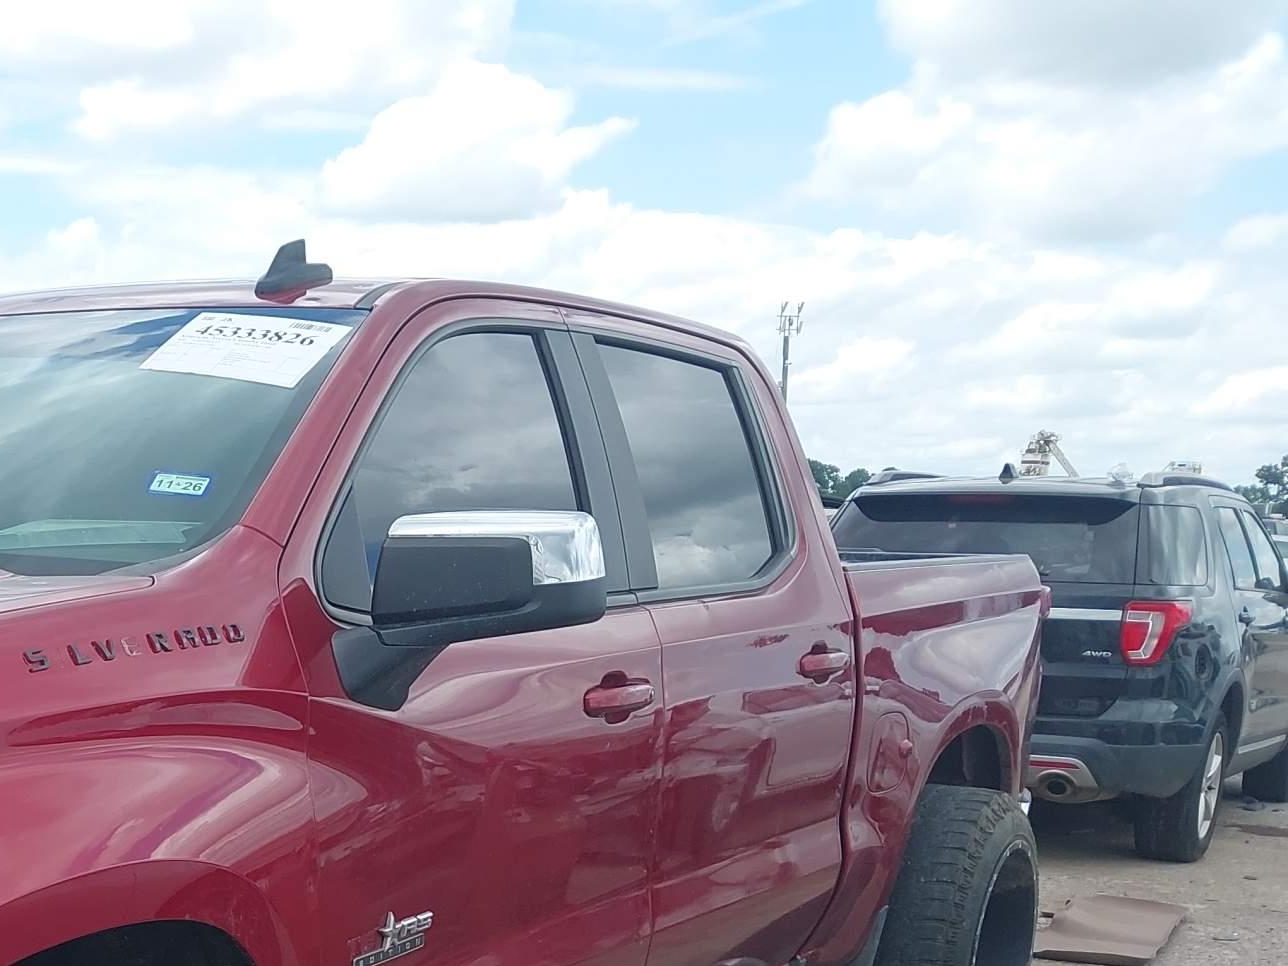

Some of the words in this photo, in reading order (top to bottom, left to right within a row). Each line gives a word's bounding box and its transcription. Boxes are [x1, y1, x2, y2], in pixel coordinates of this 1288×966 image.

[196, 323, 320, 346] 45333826
[22, 623, 246, 673] SLVERADO
[1081, 650, 1113, 658] 4WD
